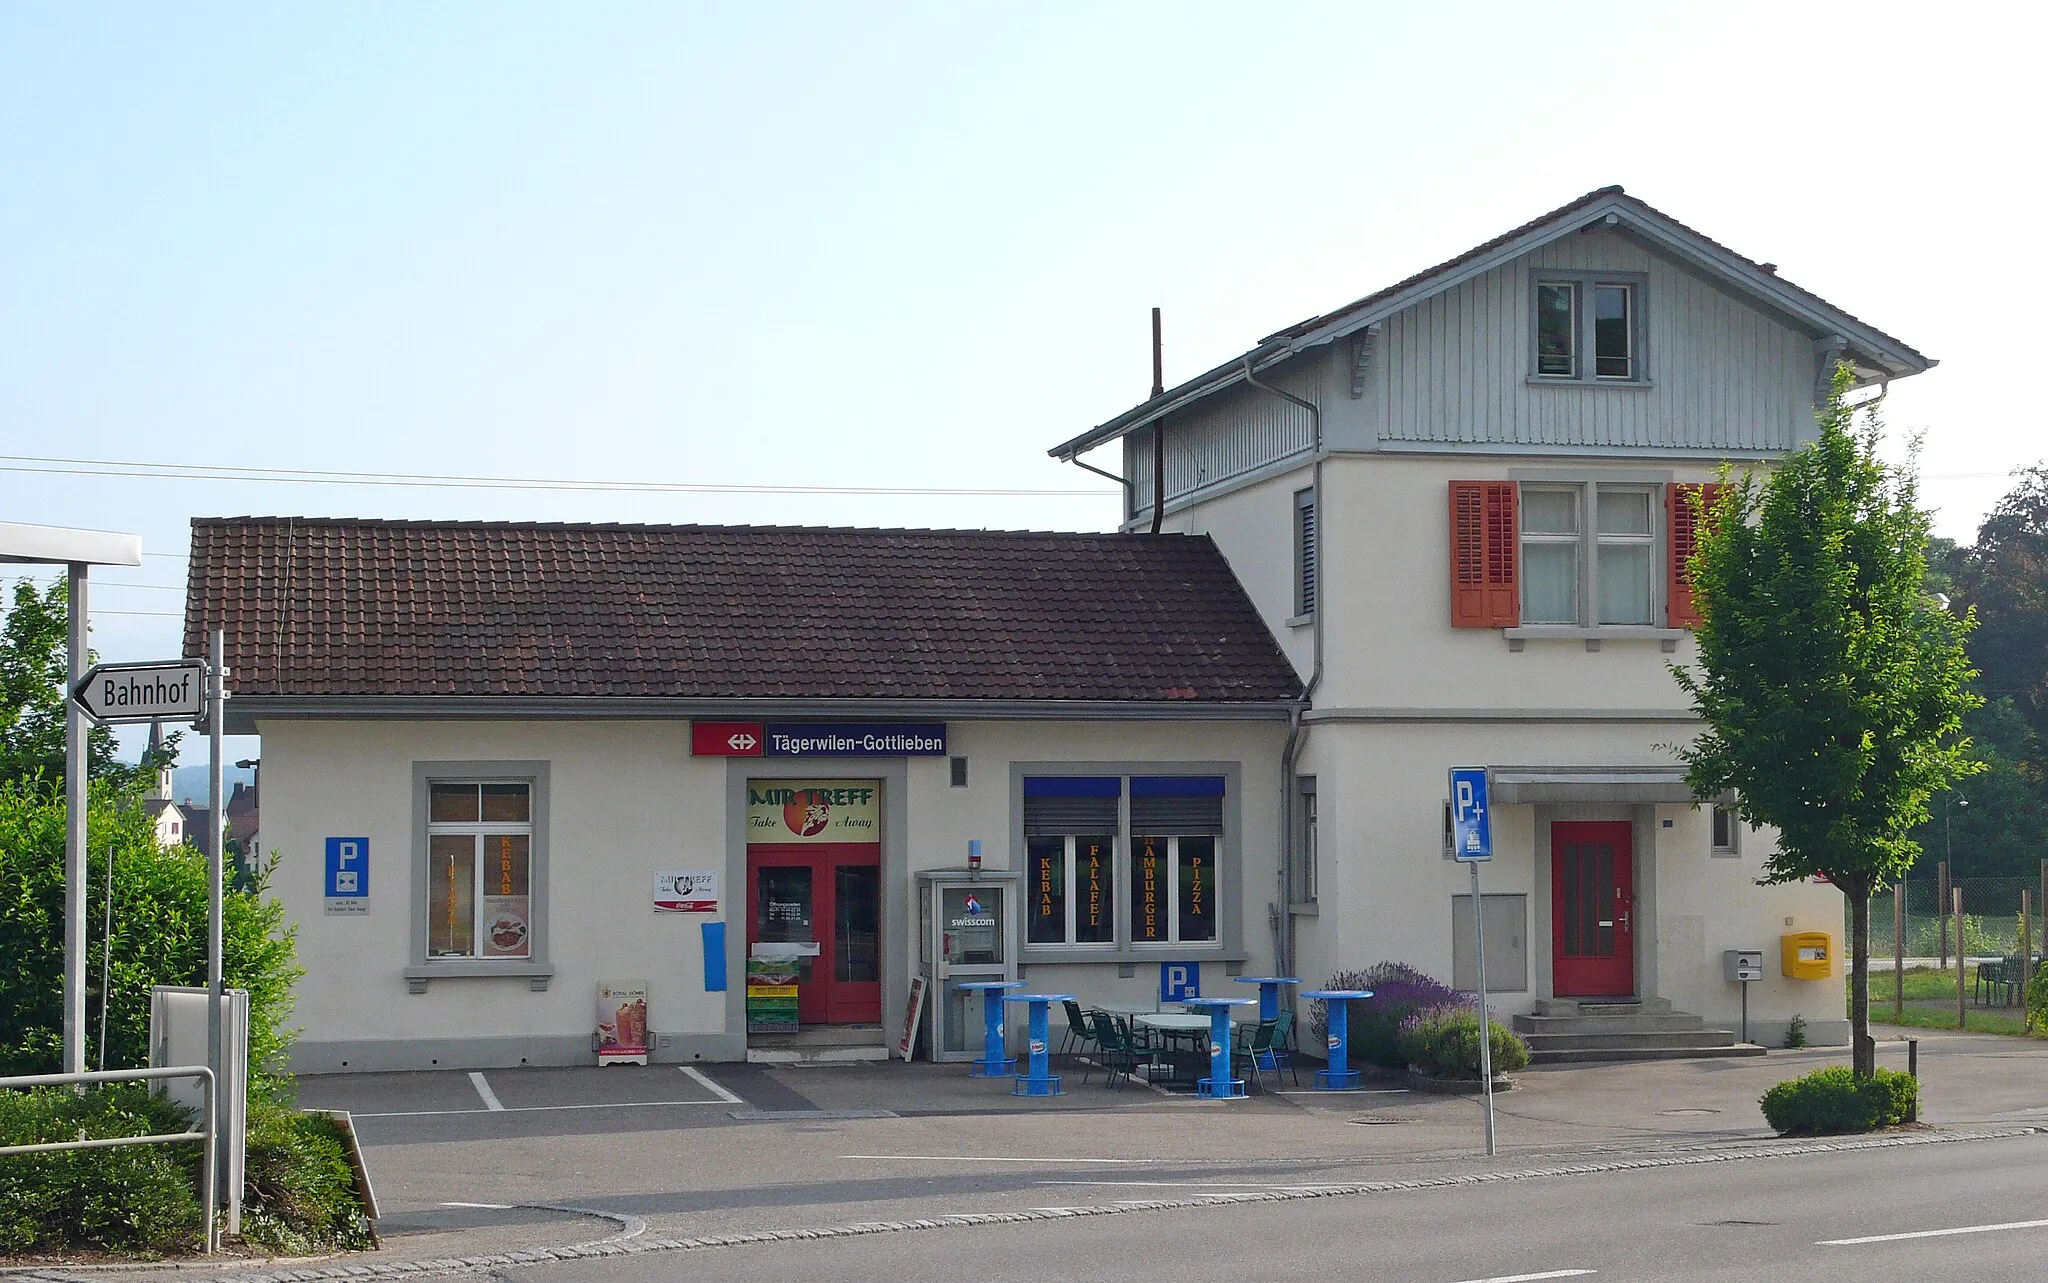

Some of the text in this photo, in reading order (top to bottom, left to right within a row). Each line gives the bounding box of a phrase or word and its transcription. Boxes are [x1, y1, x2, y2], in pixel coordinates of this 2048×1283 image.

[104, 673, 190, 707] Bahnhof
[772, 734, 942, 754] Tägerwilen-Gottlieben
[749, 787, 874, 806] MIR TREFF
[750, 816, 872, 829] Take Away
[339, 842, 358, 870] P
[501, 836, 512, 895] KEBAB
[1041, 858, 1051, 916] KEBAB
[1089, 845, 1100, 926] FALAFEL
[951, 917, 995, 926] swisscom
[1168, 966, 1187, 996] P
